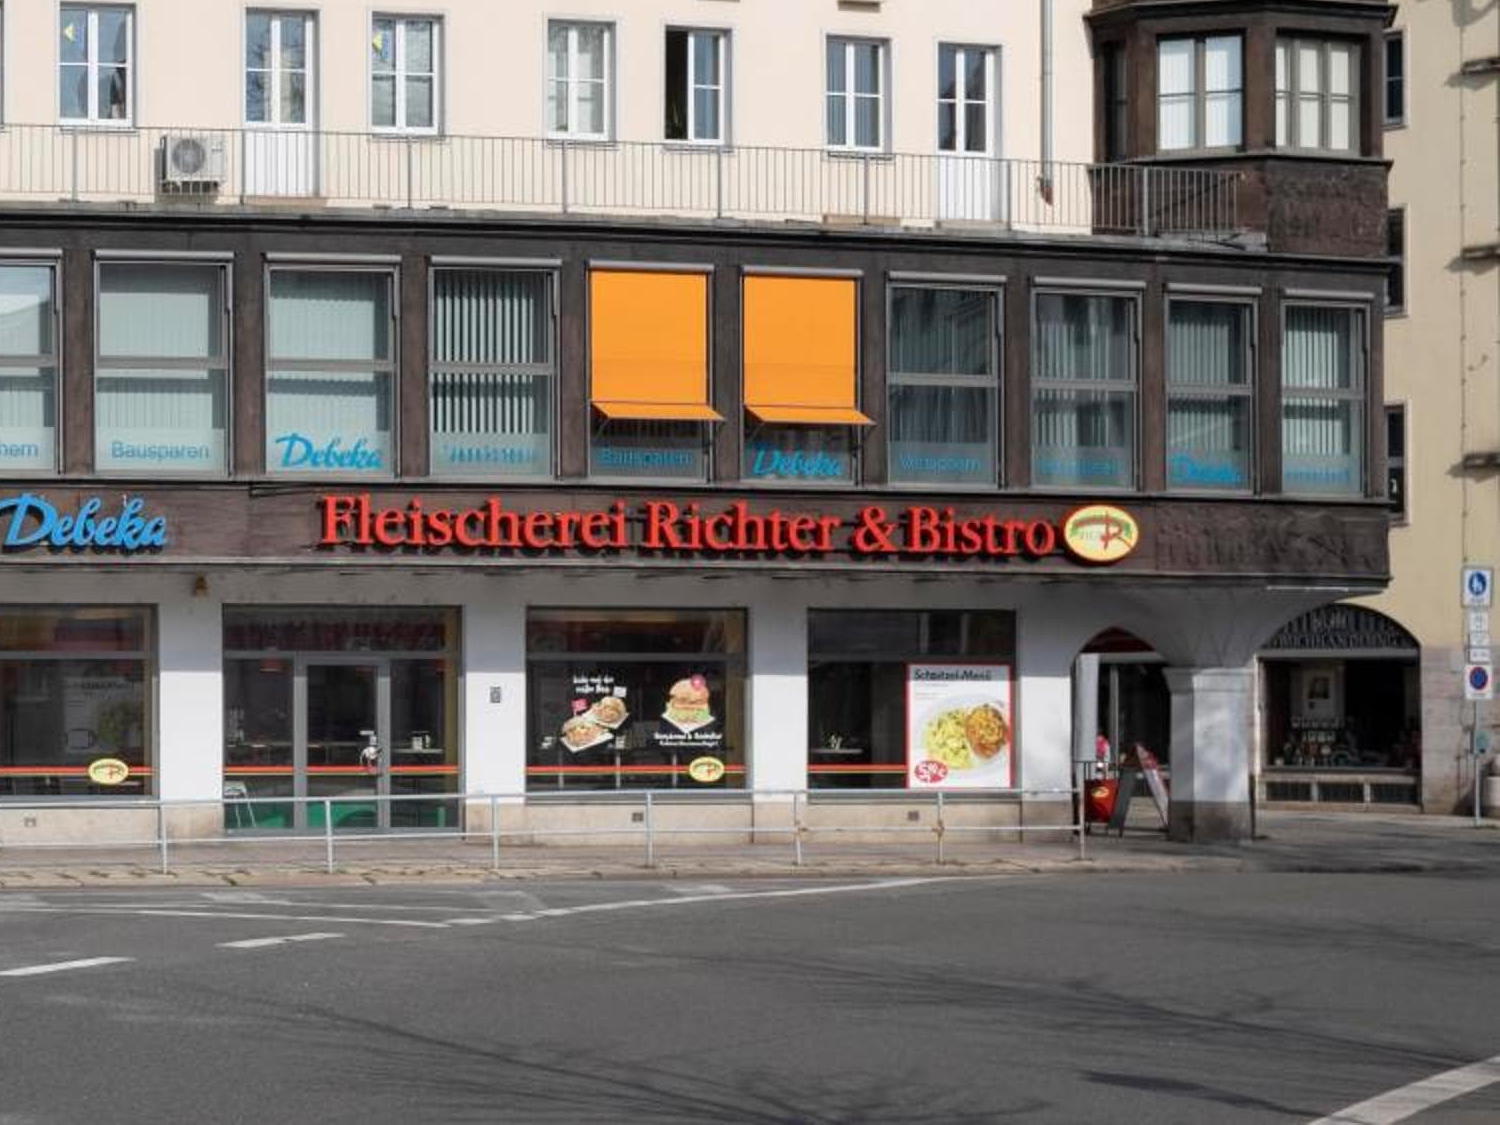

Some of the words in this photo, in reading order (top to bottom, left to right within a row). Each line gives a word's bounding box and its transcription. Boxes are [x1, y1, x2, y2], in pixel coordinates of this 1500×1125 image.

[111, 440, 210, 462] Bausparen
[274, 432, 384, 471] Debeka
[319, 493, 629, 549] Fleischerei
[644, 501, 841, 552] Richter
[850, 506, 902, 553] &
[907, 506, 1056, 555] Bistro
